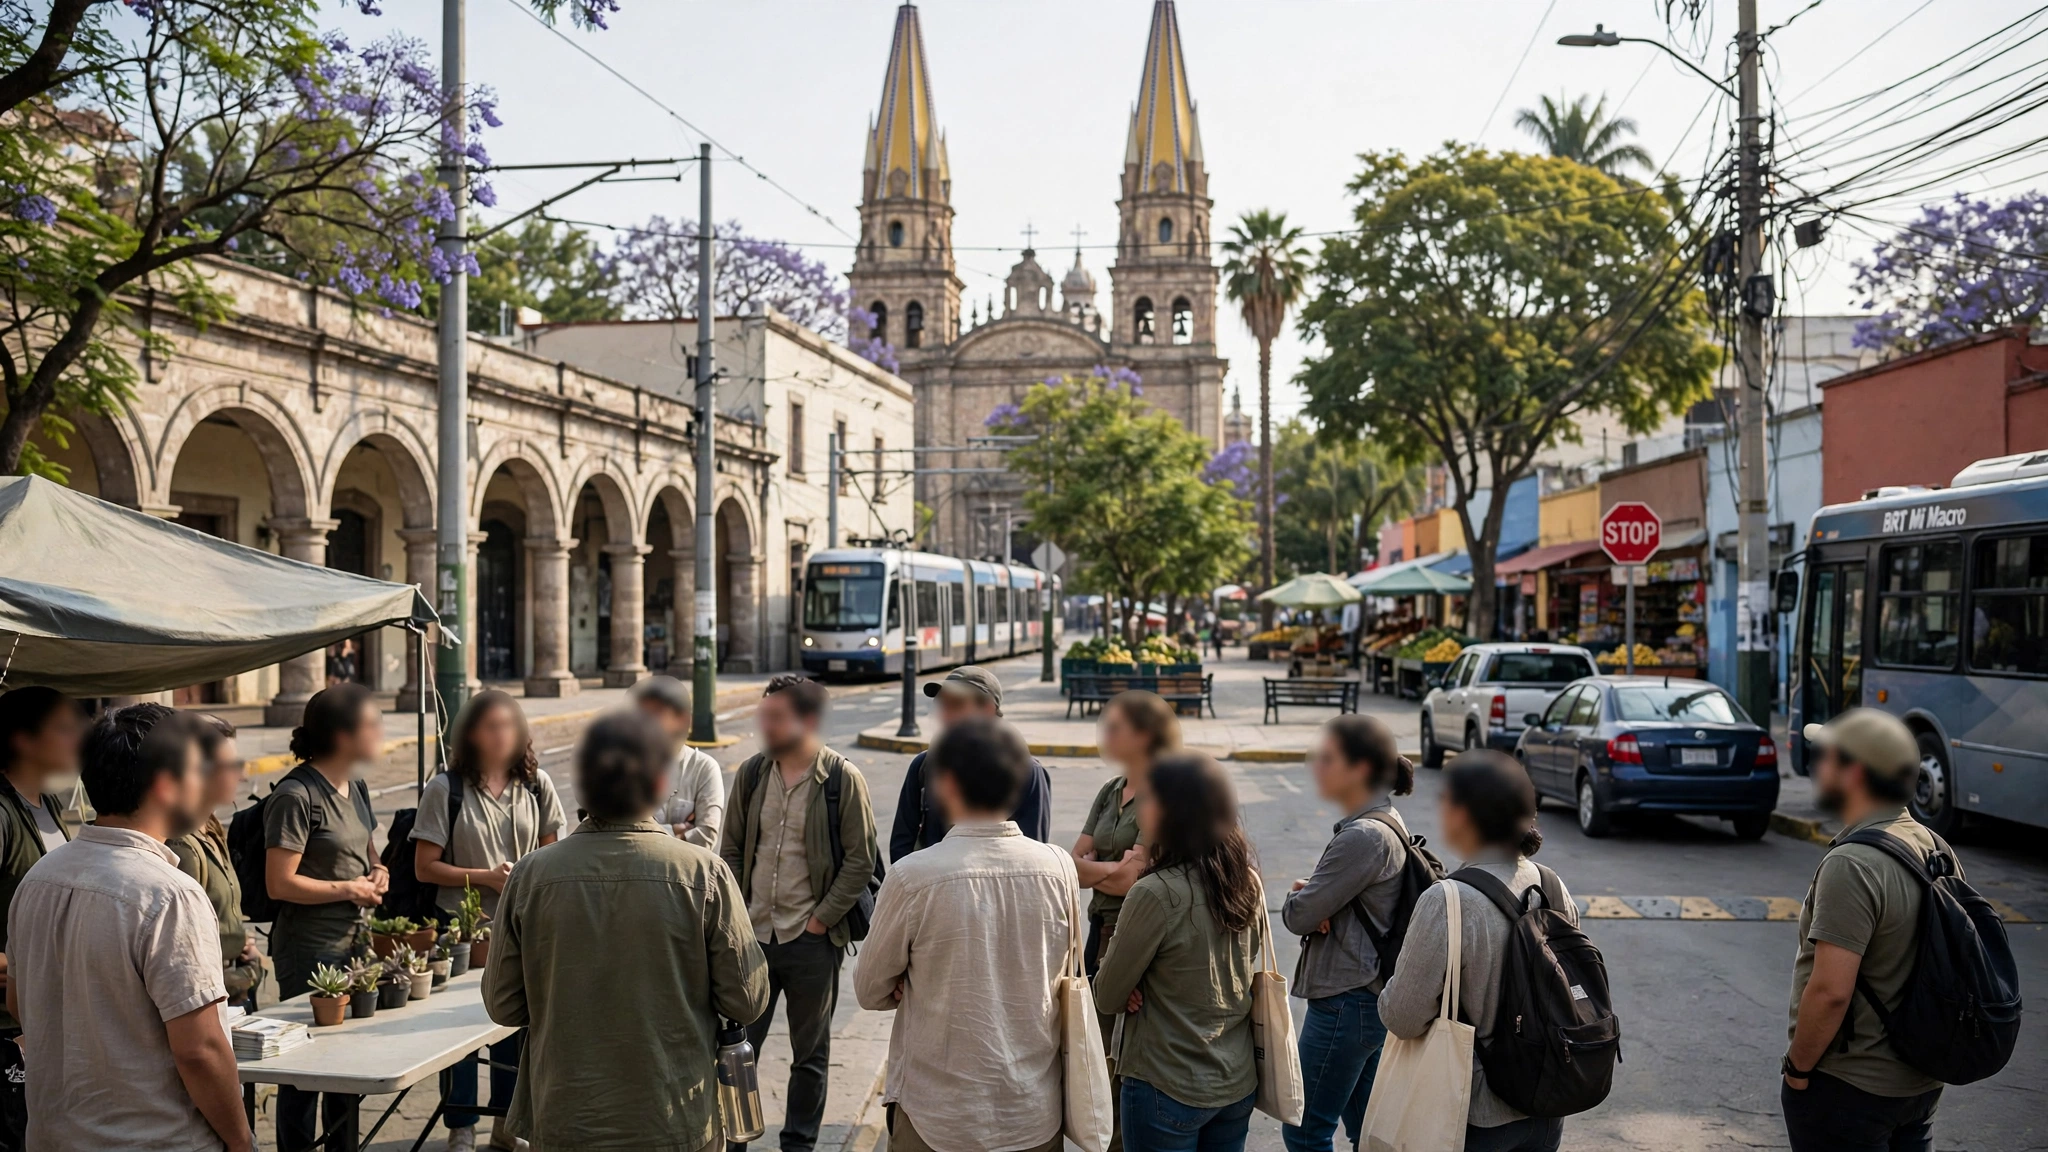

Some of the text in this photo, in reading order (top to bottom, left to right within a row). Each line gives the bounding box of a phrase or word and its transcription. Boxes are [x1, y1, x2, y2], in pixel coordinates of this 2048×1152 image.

[1882, 505, 1967, 533] BRT Mi Macro
[1605, 521, 1657, 545] STOP
